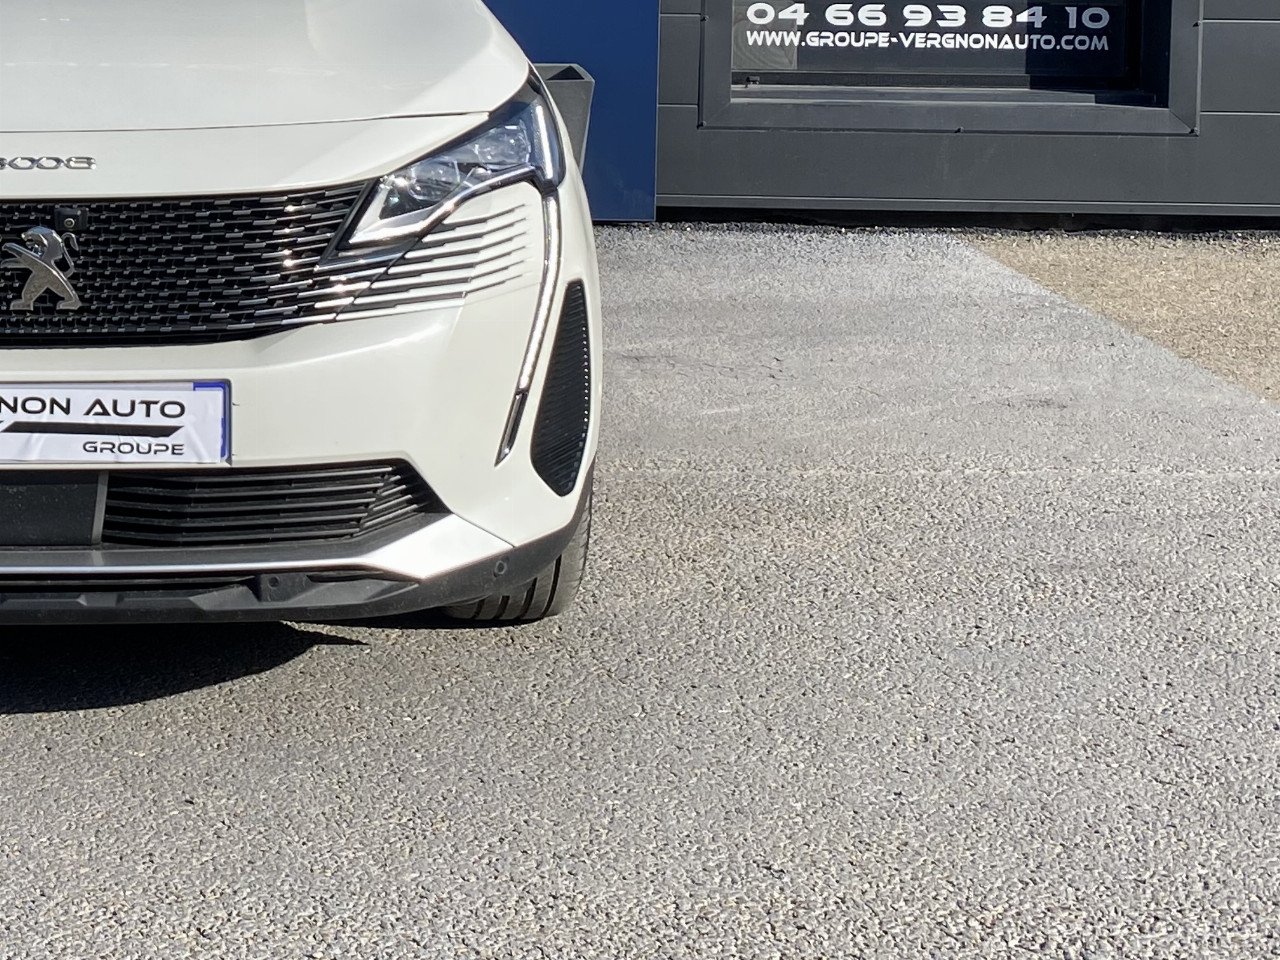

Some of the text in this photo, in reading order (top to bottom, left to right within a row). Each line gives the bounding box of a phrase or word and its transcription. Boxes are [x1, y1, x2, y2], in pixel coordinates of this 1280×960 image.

[746, 3, 1110, 28] 04 66 93 84 10
[746, 30, 1109, 51] WWW.GROUPE-VERGNONAUTO.COM
[83, 399, 186, 419] AUTO
[83, 440, 185, 457] GROUPE
